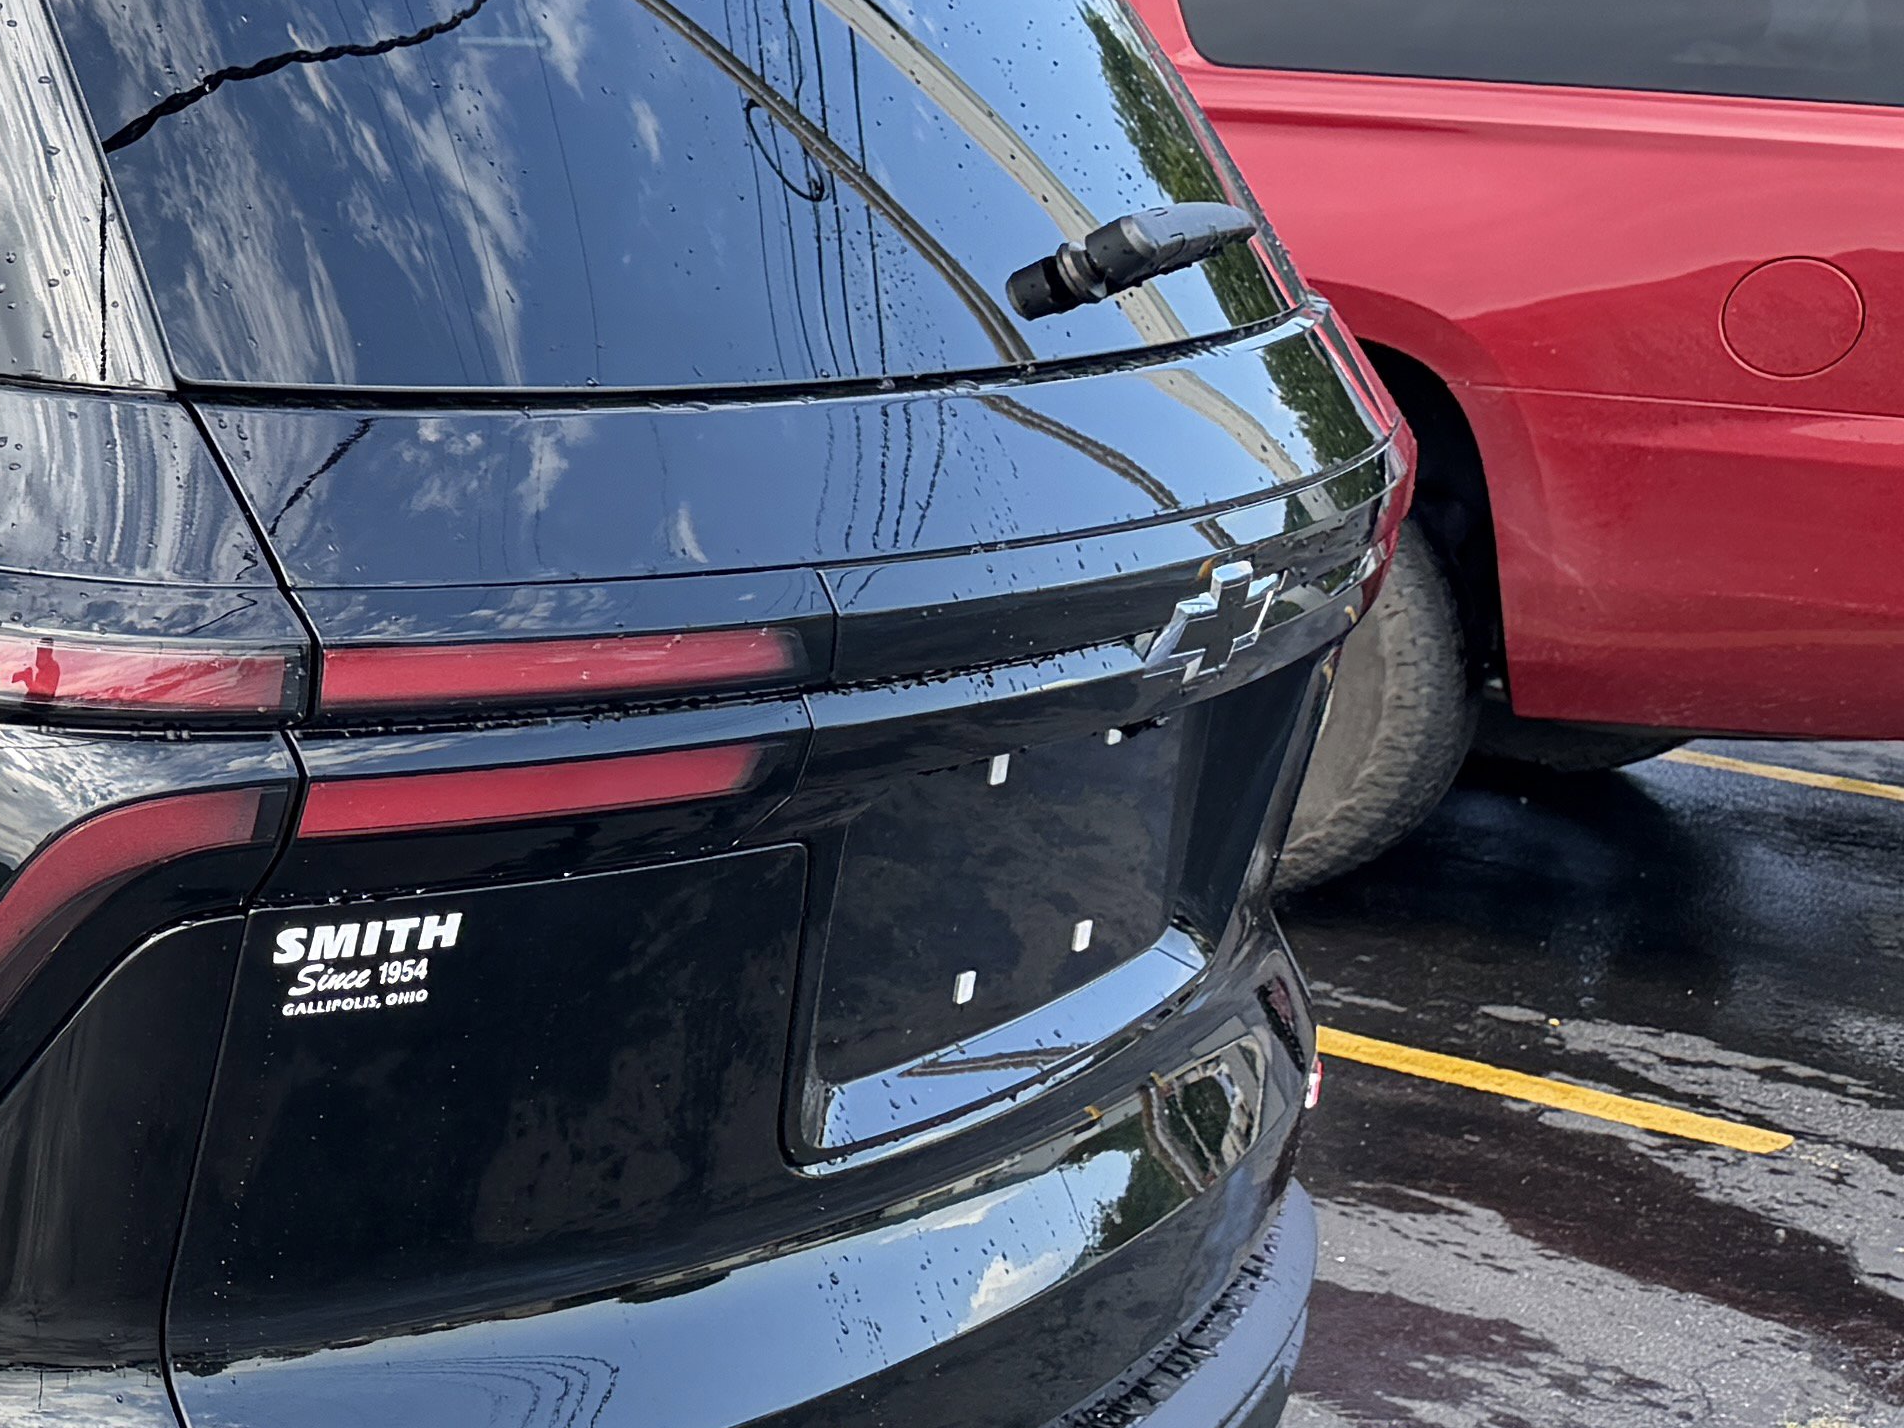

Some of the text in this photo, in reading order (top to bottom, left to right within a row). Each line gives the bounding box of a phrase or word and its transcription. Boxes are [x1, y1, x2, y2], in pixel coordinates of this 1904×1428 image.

[272, 912, 463, 964] SMITH
[288, 957, 428, 996] Since 1954
[282, 989, 428, 1017] GALLIPOLIS, OHIO
